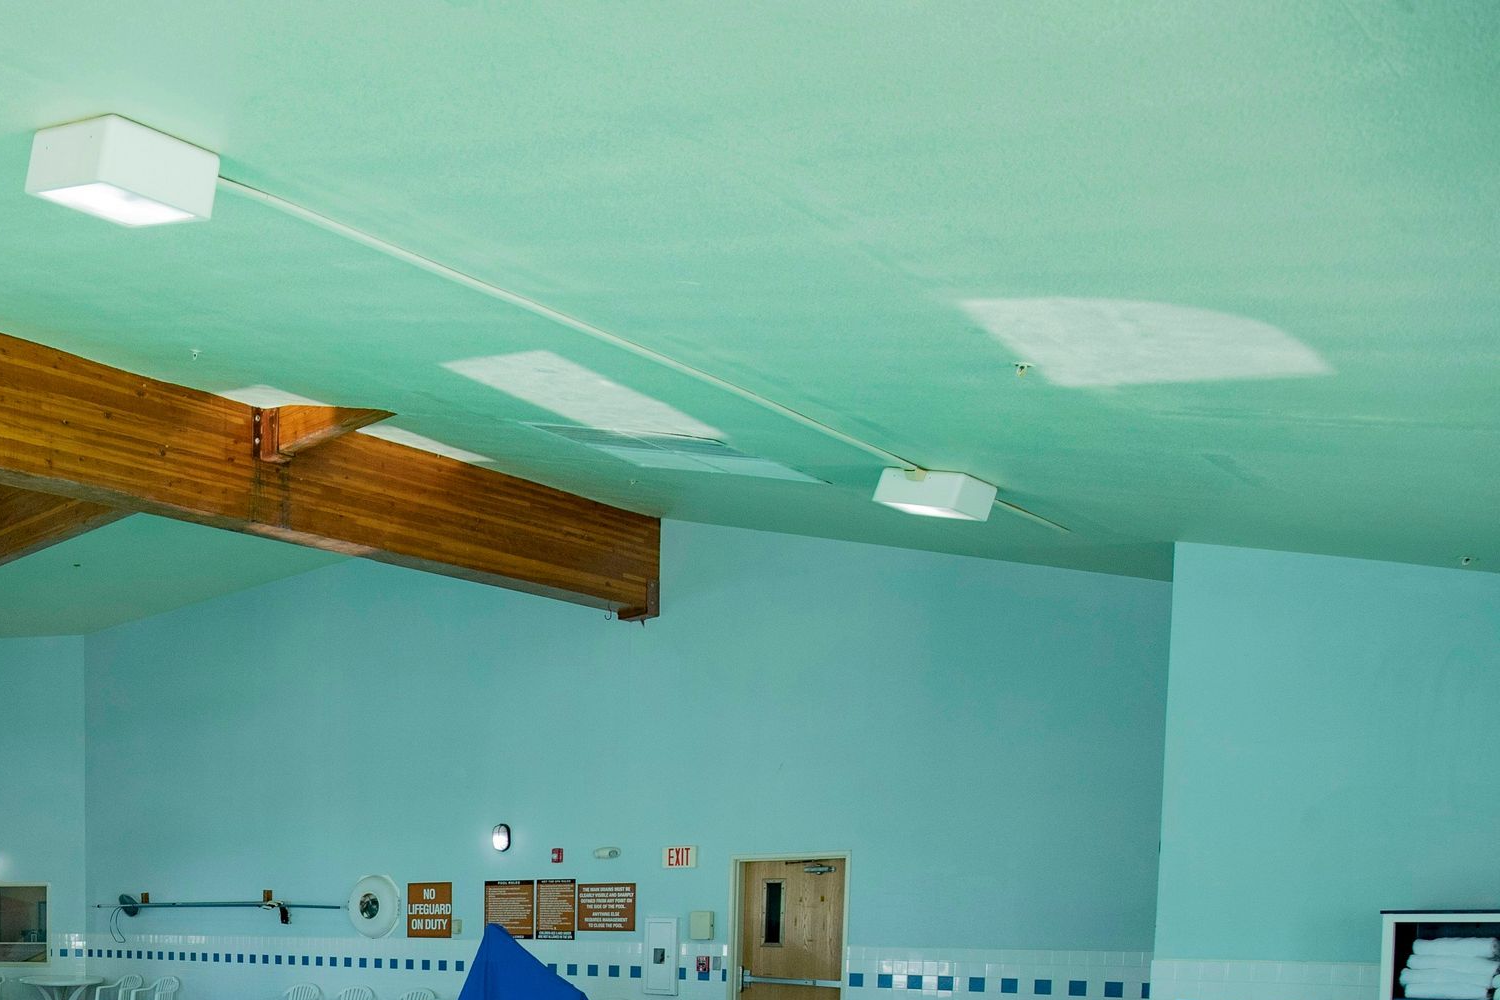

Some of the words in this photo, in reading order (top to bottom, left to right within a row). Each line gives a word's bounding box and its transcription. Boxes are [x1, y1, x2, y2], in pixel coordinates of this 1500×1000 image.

[668, 847, 691, 866] EXIT
[423, 888, 435, 900] NO
[408, 903, 451, 915] LIFEGUARD
[411, 918, 423, 930] ON
[425, 918, 448, 930] DUTY
